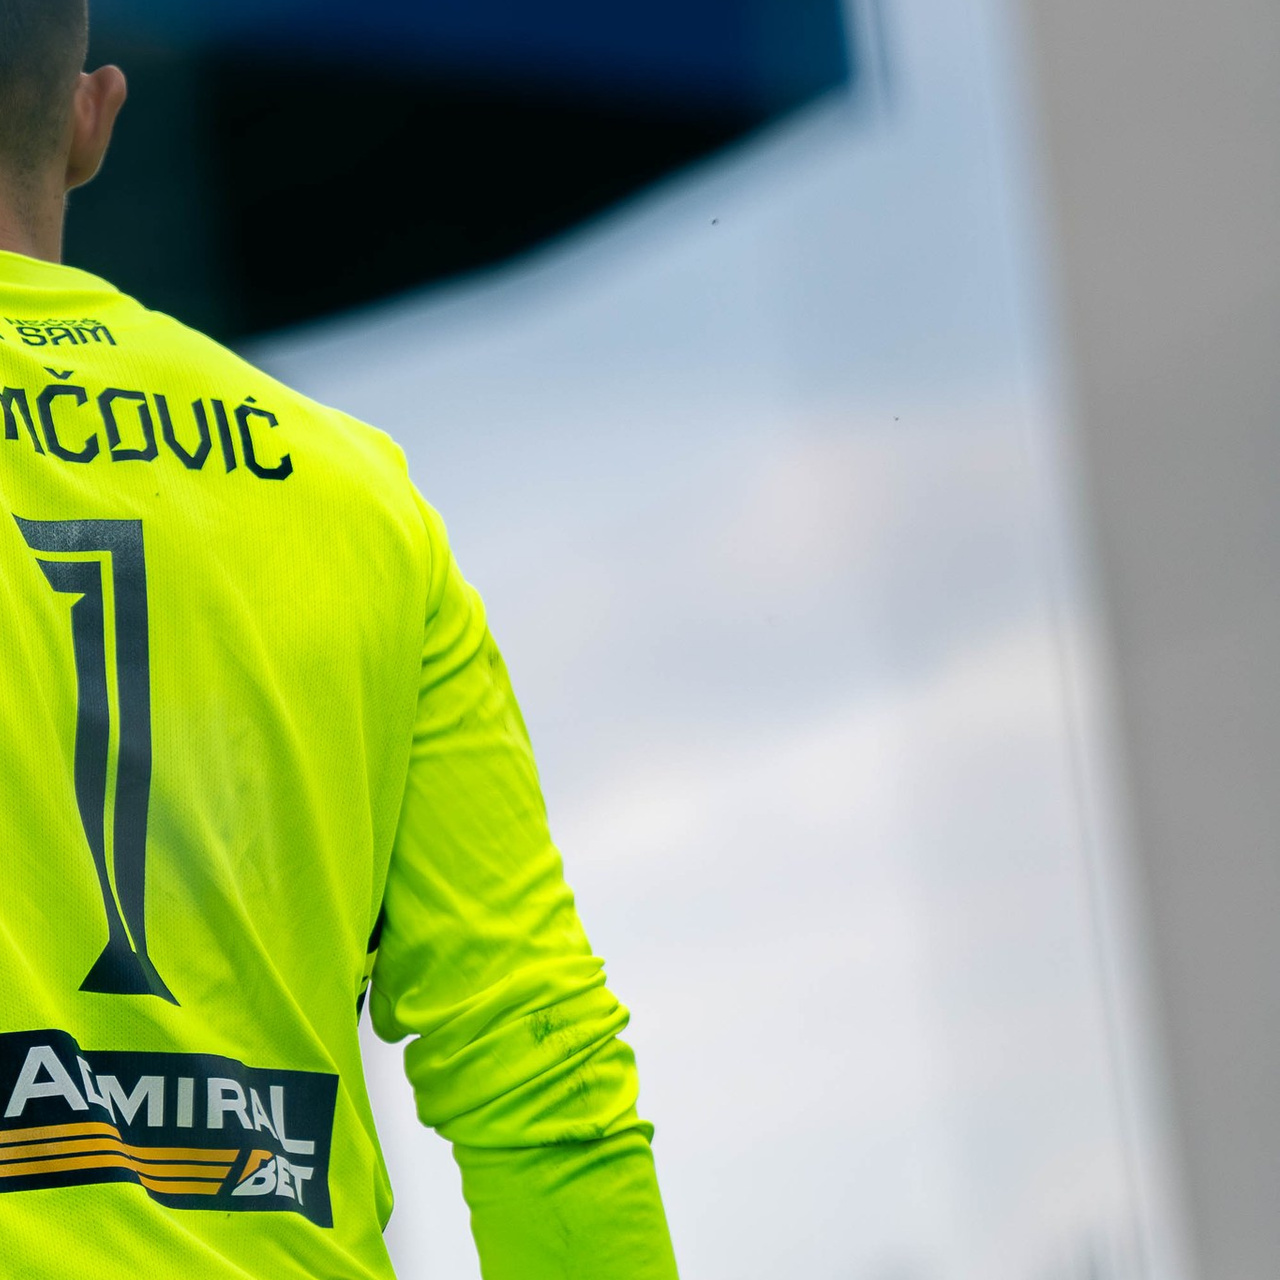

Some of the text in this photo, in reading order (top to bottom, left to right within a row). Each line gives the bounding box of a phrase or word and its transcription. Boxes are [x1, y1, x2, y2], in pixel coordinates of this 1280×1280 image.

[15, 326, 118, 347] SAM
[11, 512, 182, 1008] 1
[230, 1149, 315, 1206] BET
